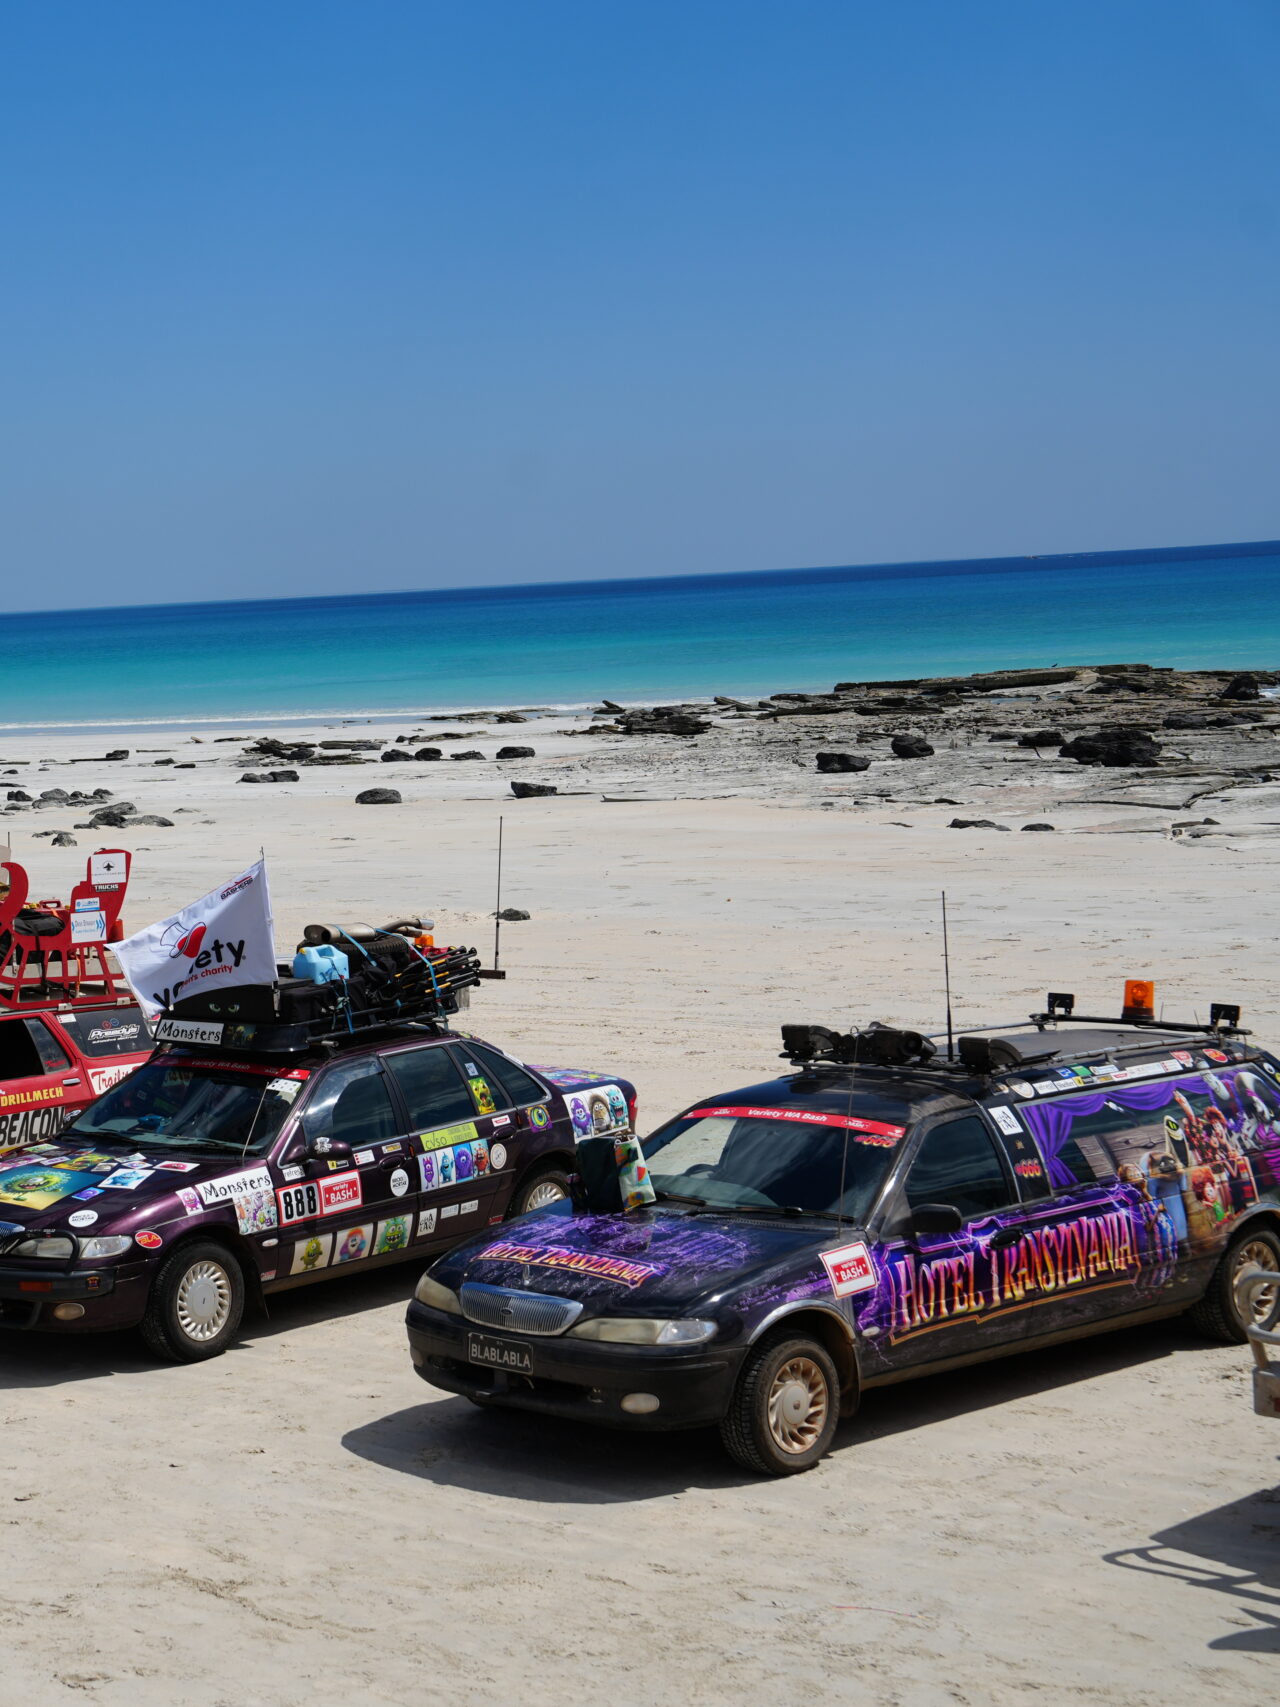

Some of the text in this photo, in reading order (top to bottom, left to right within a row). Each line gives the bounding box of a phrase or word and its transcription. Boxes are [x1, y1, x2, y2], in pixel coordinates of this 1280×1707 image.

[200, 964, 233, 978] charity
[0, 1087, 65, 1107] DRILLMECH
[747, 1108, 783, 1118] Variety
[783, 1110, 803, 1119] WA
[803, 1112, 828, 1122] Bash
[203, 1173, 271, 1200] Monsters
[332, 1183, 349, 1191] variety
[283, 1185, 318, 1220] 888
[330, 1188, 353, 1203] BASH
[479, 1243, 651, 1282] HOTEL TRANSYLVANIA
[841, 1261, 857, 1269] variety
[894, 1211, 1137, 1331] HOTEL TRANSYLVANIA
[840, 1265, 865, 1280] BASH
[470, 1343, 531, 1369] BLABLABLA
